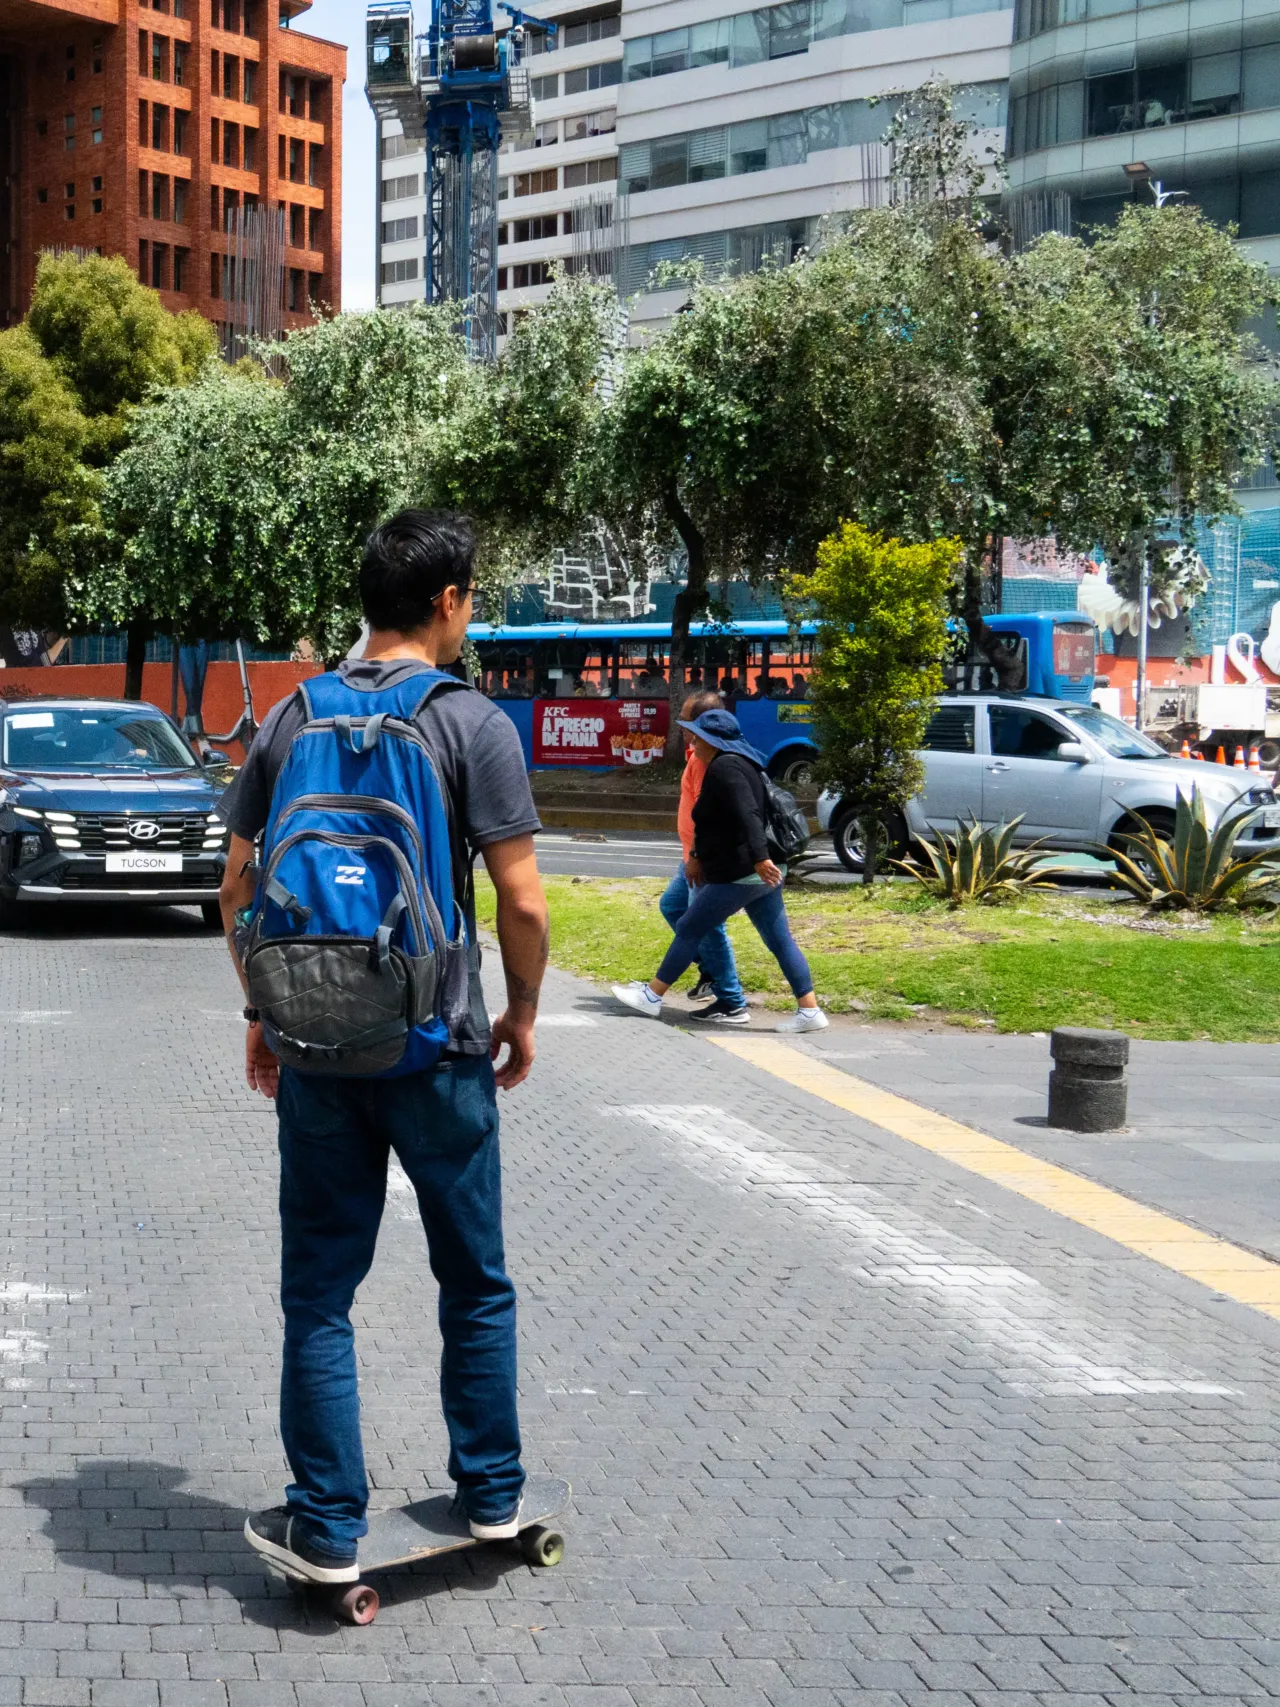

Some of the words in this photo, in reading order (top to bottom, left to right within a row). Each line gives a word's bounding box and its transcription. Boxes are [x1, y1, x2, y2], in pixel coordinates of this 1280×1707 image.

[543, 707, 569, 717] KFC
[542, 718, 552, 732] A
[554, 718, 605, 733] PRECIO
[542, 732, 560, 746] DE
[562, 732, 599, 747] PANA
[121, 858, 166, 868] TUCSON
